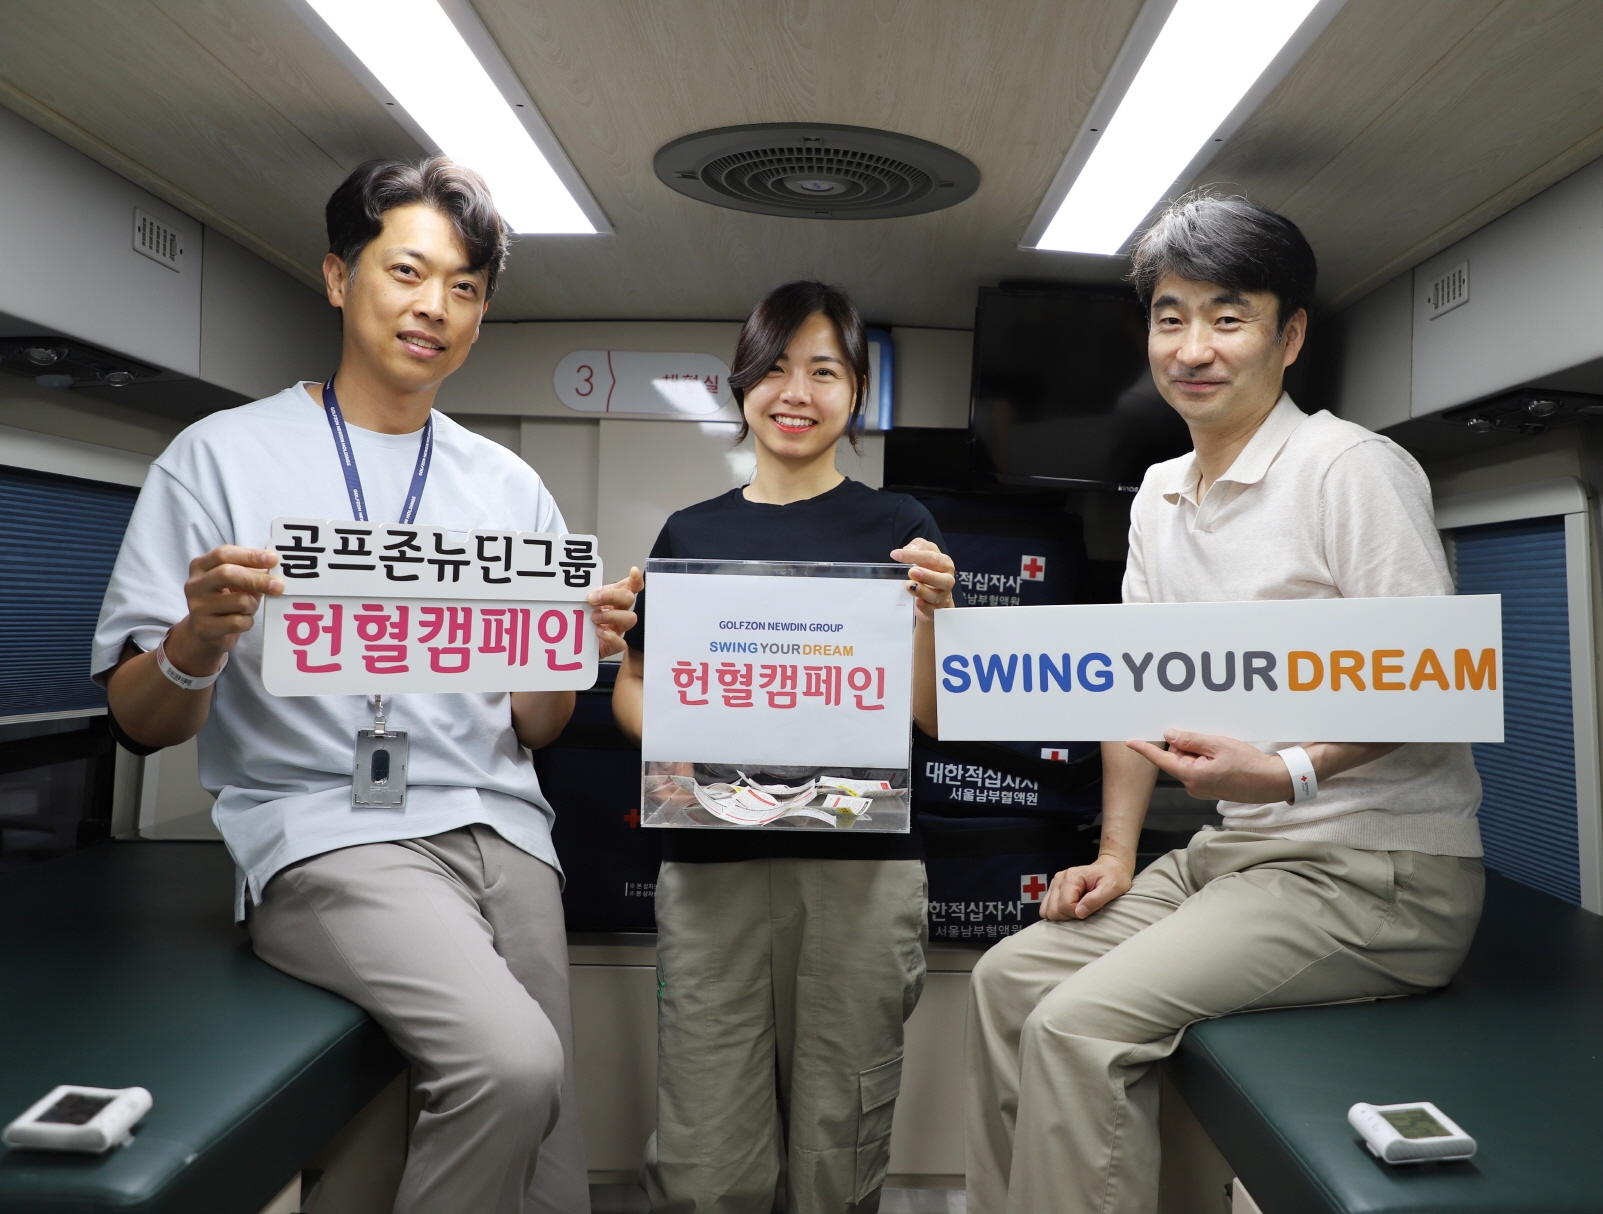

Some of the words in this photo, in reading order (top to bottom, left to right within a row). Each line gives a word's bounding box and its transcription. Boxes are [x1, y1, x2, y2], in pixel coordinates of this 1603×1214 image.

[575, 364, 594, 397] 3
[275, 523, 597, 588] 골프존뉴딘그룹
[956, 571, 1023, 594] 적십자사
[283, 602, 585, 675] 헌혈캠페인
[719, 620, 766, 631] GOLFZON
[767, 622, 807, 632] NEWDIN
[809, 623, 844, 633] GROUP
[671, 660, 886, 711] 헌혈캠페인
[949, 787, 1039, 806] 서울남부혈액원
